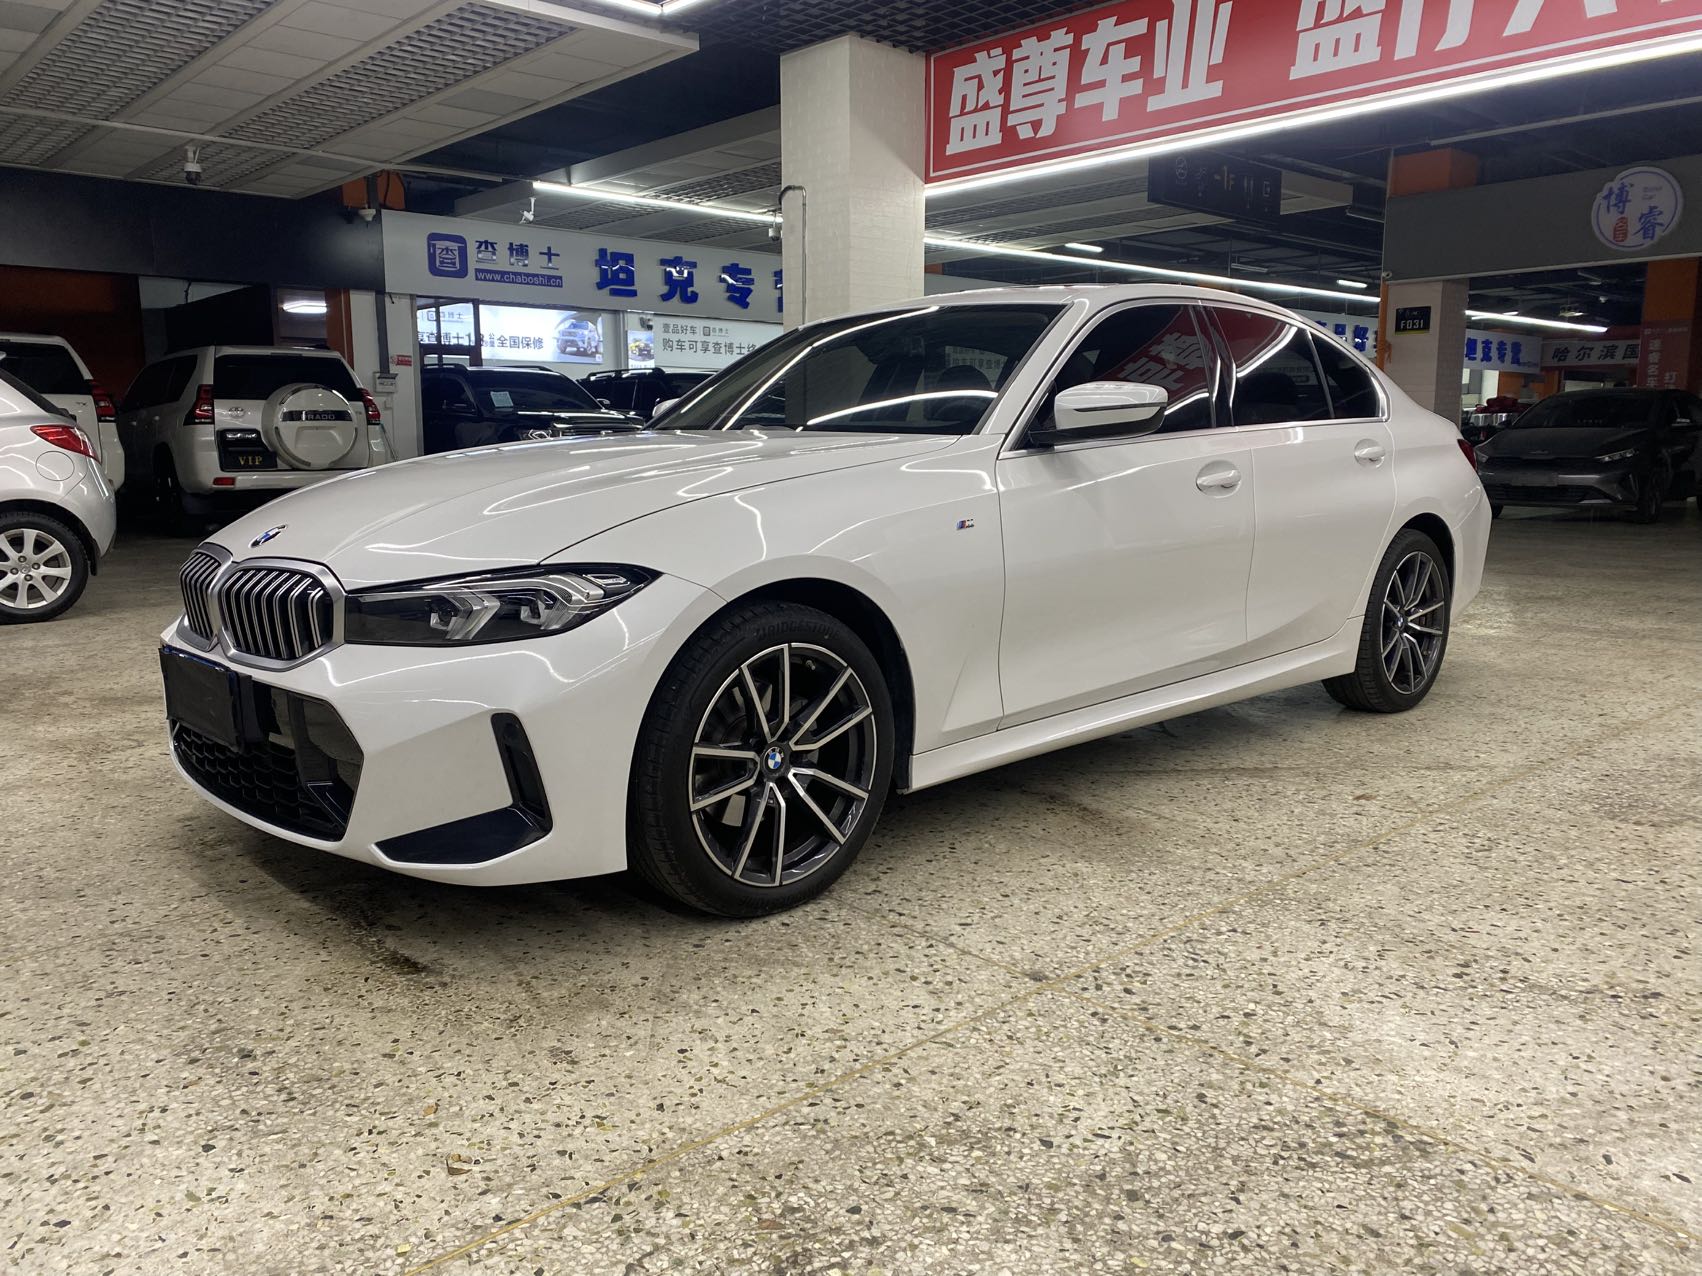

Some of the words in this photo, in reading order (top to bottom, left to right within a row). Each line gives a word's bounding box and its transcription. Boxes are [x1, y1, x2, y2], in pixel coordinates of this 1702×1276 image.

[946, 0, 1232, 155] 盛尊车业
[475, 240, 560, 270] 查博士
[476, 271, 562, 287] www.chaboshi.cn
[595, 248, 783, 313] 坦克专
[662, 323, 698, 336] 壹品好车
[1400, 319, 1424, 329] F031
[496, 335, 544, 350] 全国保修
[1551, 343, 1640, 363] 哈尔滨国
[239, 455, 263, 466] VIP
